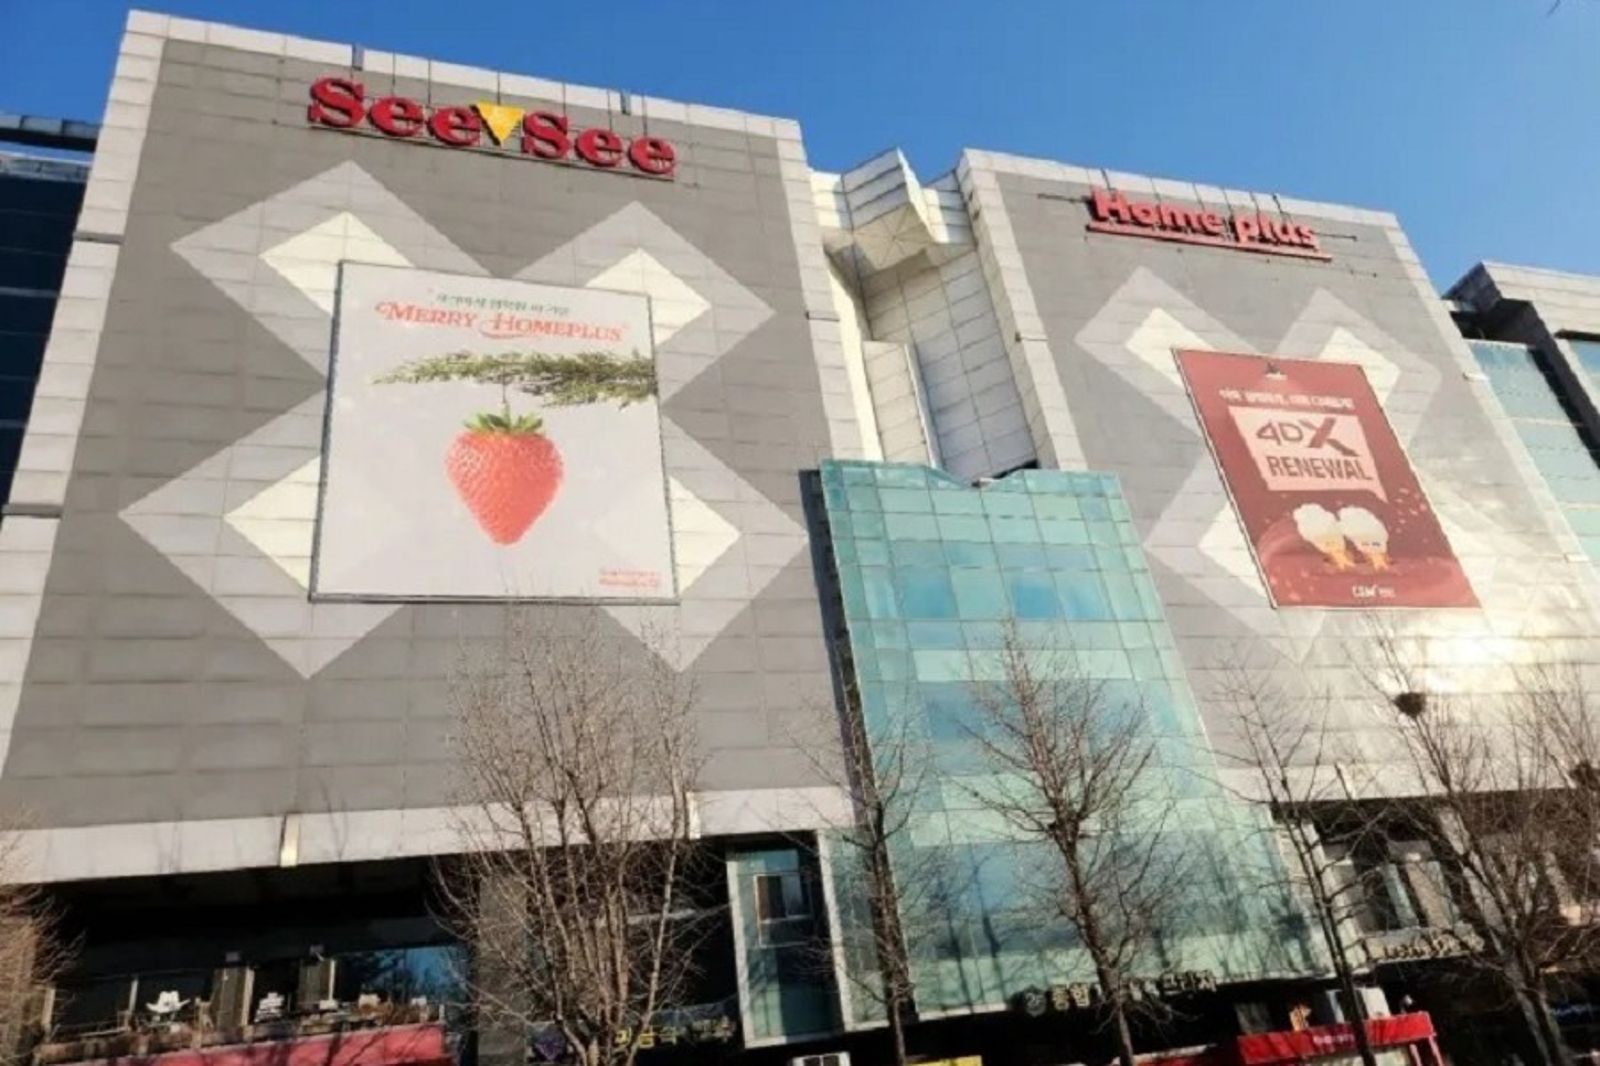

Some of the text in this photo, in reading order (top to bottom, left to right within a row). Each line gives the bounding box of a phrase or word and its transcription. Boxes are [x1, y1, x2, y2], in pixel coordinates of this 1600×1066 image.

[308, 77, 675, 175] See See
[1091, 190, 1316, 248] Home plus
[482, 311, 622, 341] HOMEPLUS
[1256, 417, 1359, 457] 4DX
[1265, 455, 1374, 481] RENEWAL
